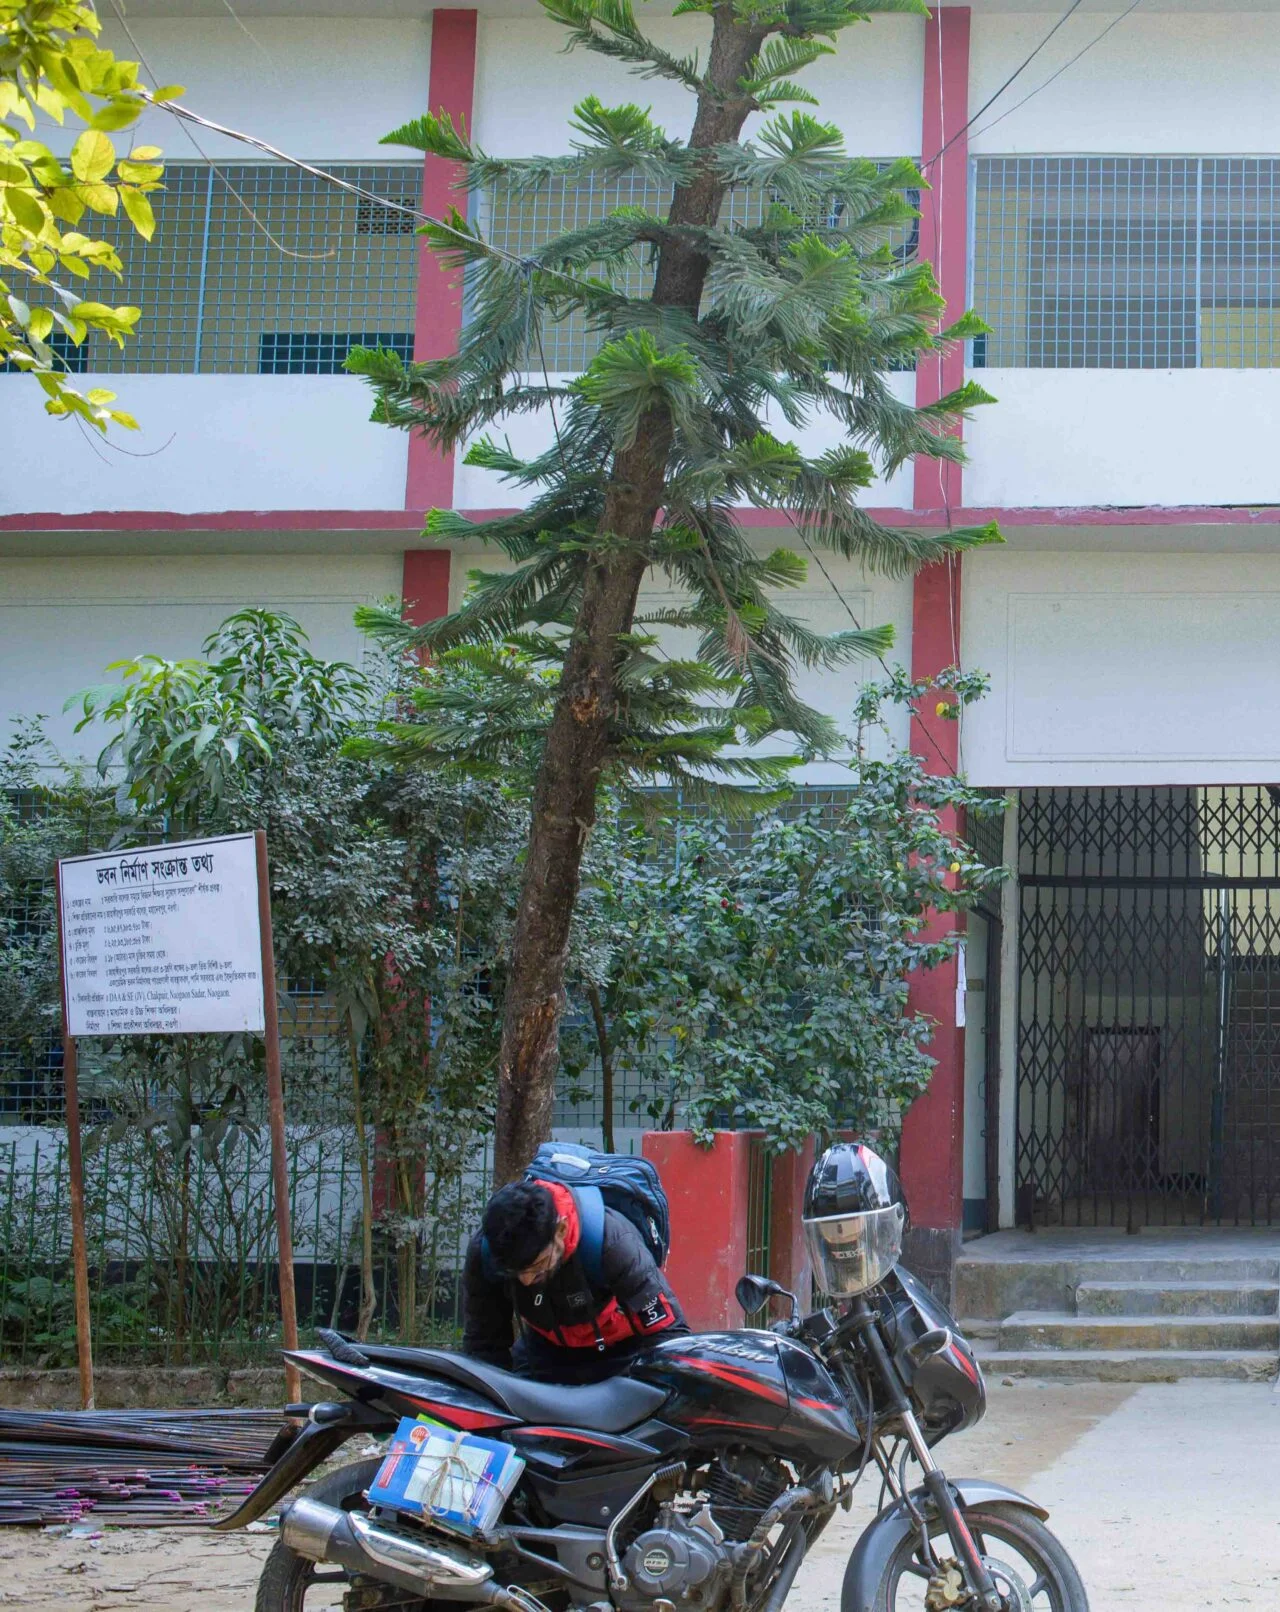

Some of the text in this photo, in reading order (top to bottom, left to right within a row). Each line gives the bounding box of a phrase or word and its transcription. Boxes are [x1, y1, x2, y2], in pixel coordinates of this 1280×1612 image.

[96, 852, 214, 886] ভবন নির্মাণ সংক্রান্ত তথ্য
